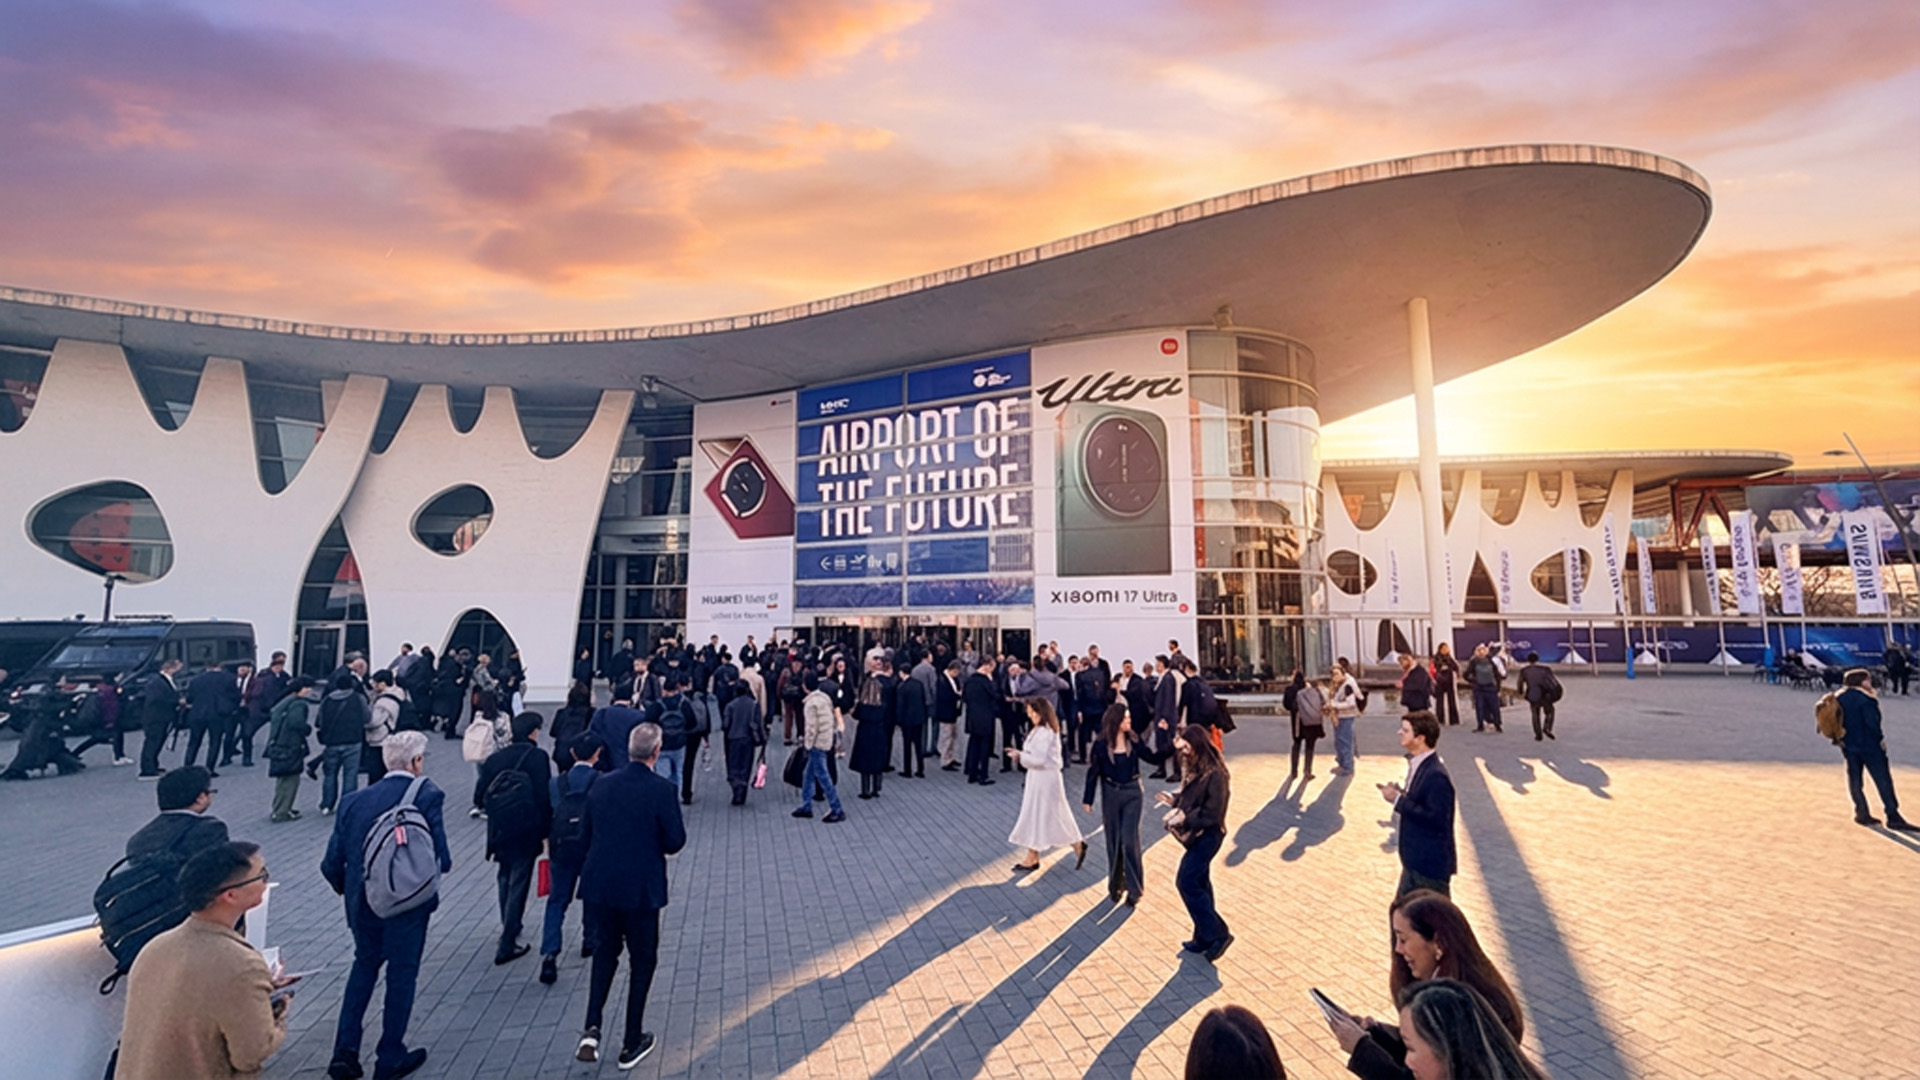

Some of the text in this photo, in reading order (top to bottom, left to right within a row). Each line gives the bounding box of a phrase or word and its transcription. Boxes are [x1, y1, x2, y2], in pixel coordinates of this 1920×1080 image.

[1036, 371, 1183, 408] Ultra
[817, 397, 1019, 476] AIRPORT OF
[817, 463, 1019, 537] THE FUTURE
[1123, 590, 1139, 603] 17
